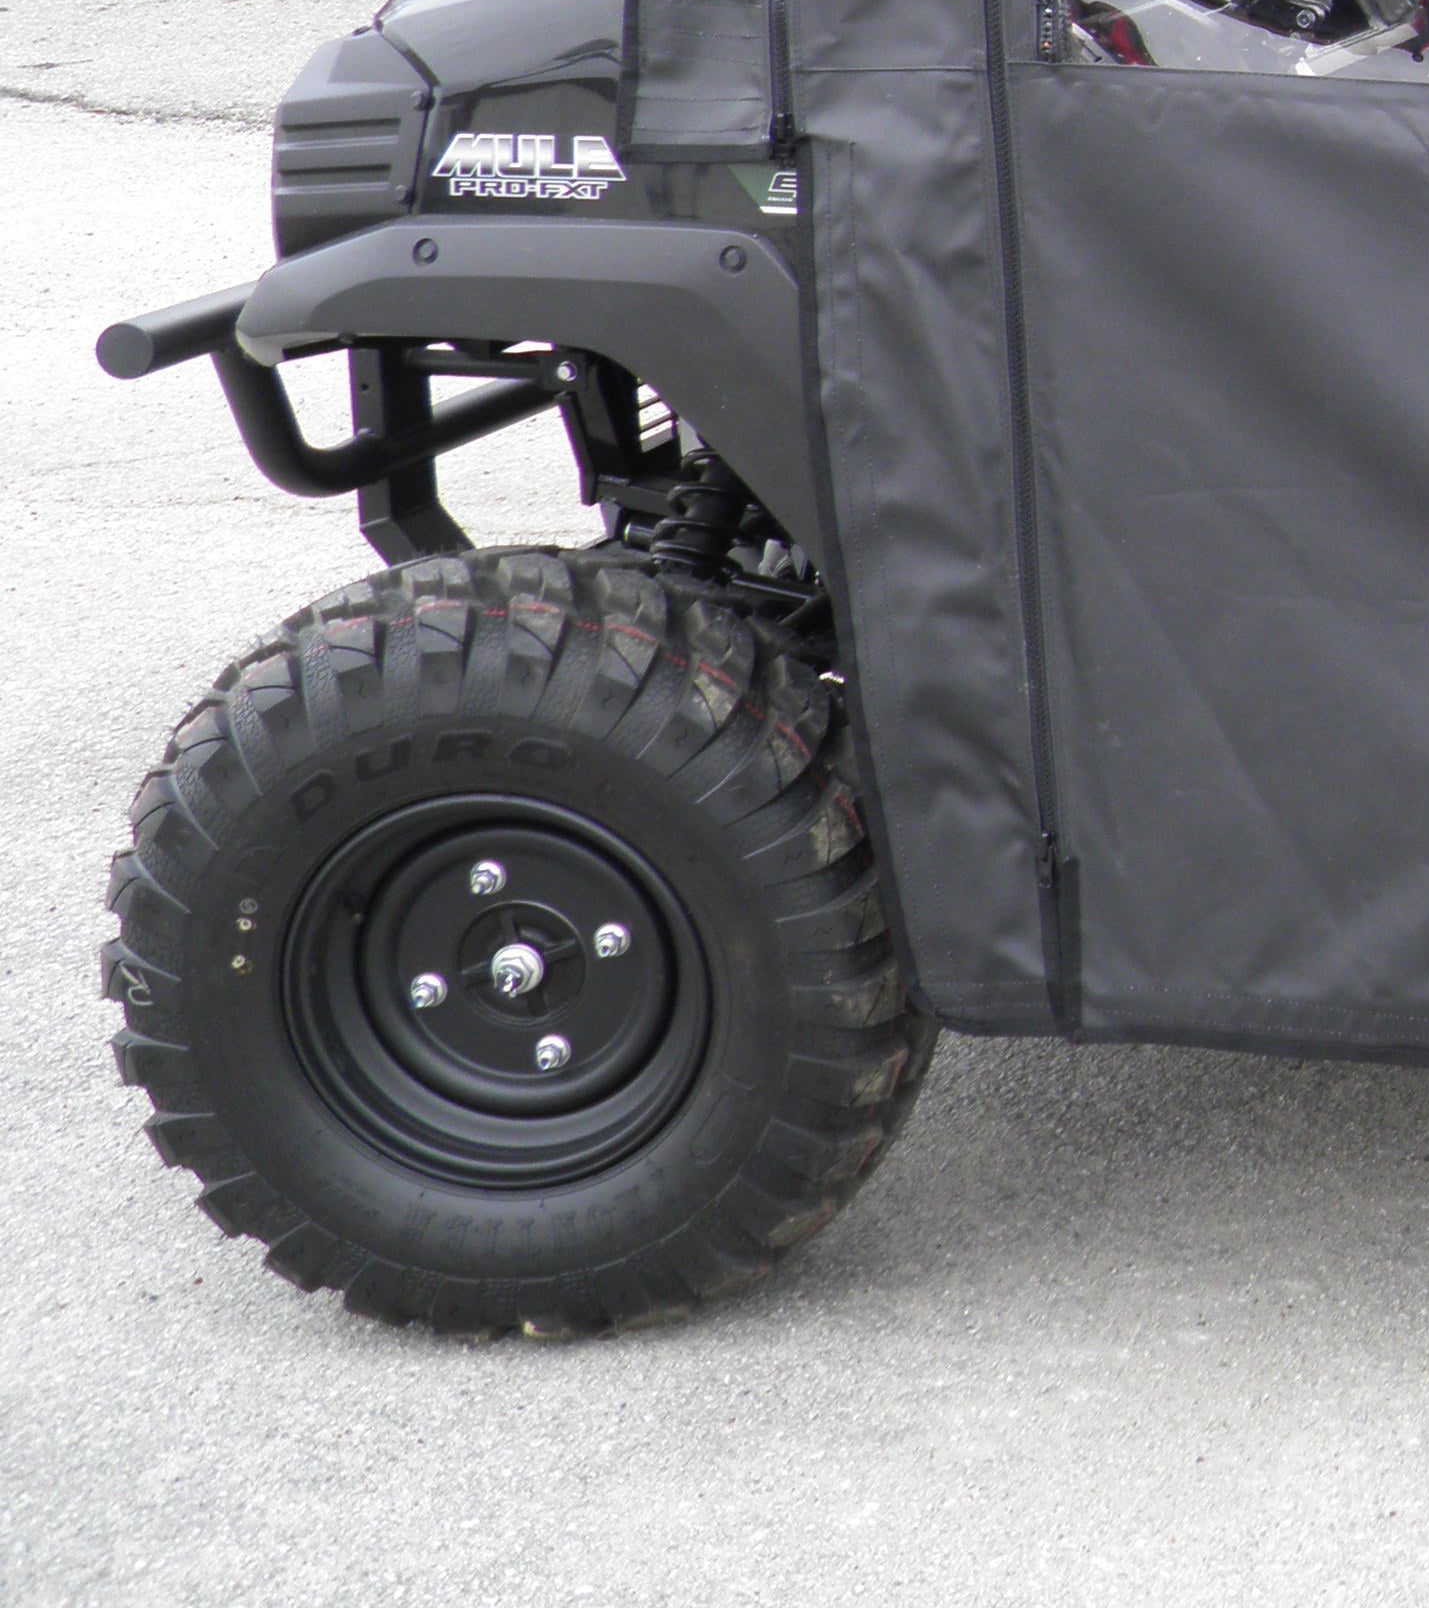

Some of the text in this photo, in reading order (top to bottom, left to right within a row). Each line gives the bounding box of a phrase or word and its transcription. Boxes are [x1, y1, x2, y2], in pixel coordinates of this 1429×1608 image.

[432, 133, 627, 181] MULE
[449, 177, 608, 200] PRO-FXT
[286, 727, 575, 826] DURO
